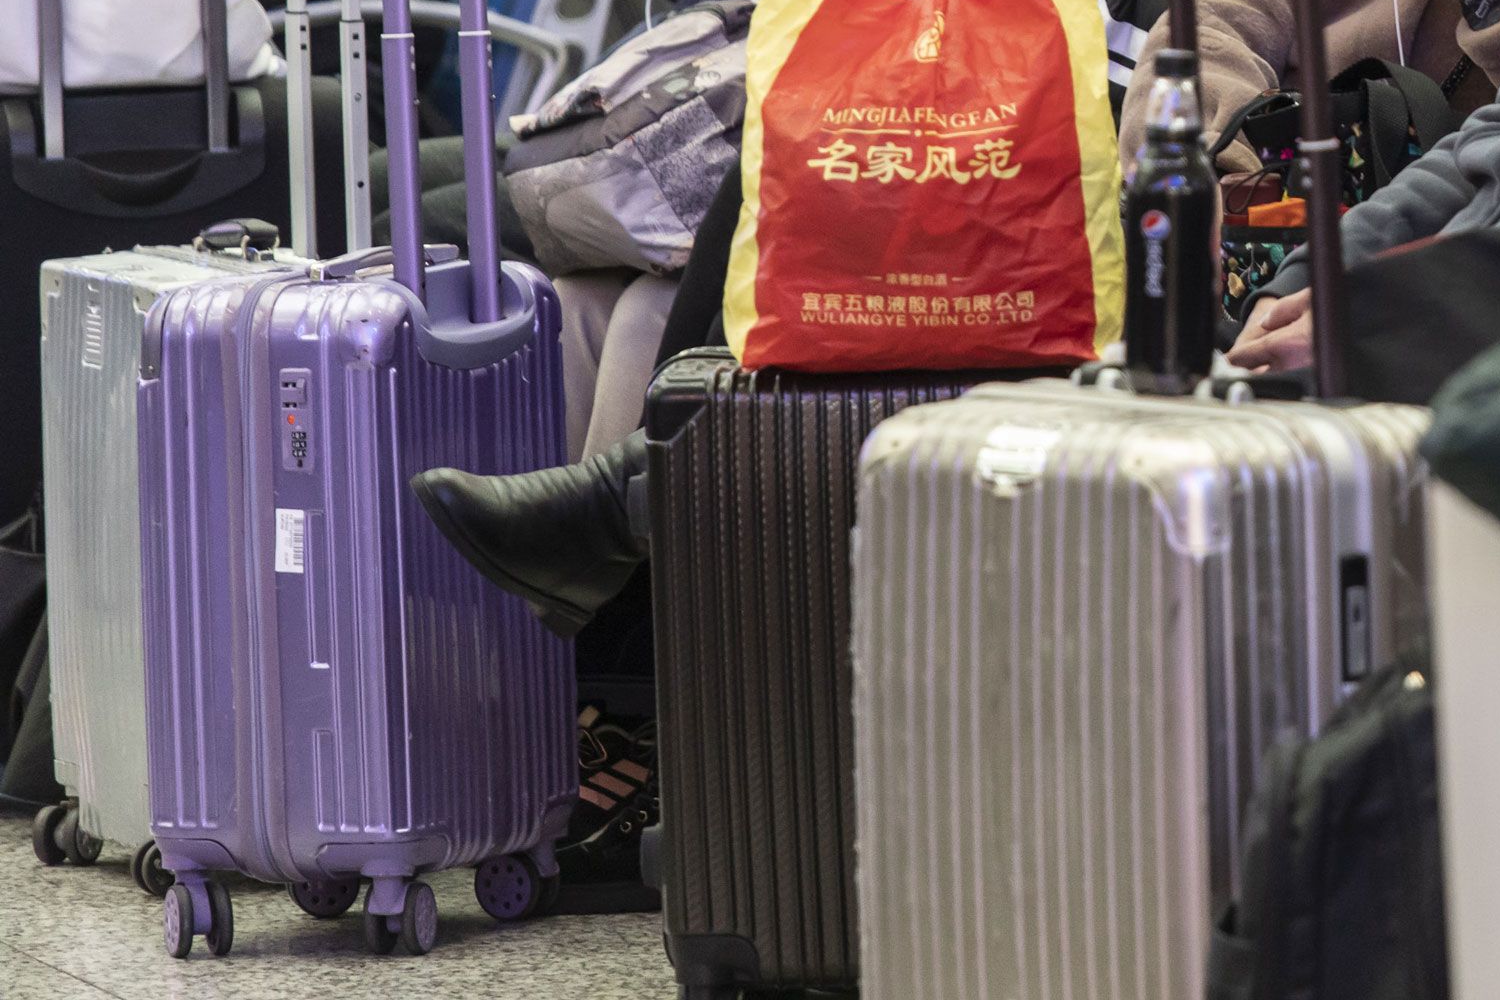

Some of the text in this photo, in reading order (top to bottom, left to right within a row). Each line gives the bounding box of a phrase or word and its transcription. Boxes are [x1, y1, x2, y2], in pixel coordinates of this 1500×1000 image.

[822, 102, 1018, 129] MINGJIAFENGFAN
[806, 137, 1022, 185] 名家风范
[801, 290, 1035, 315] 宜宾五粮液股份有限公司
[800, 311, 906, 327] WULIANGYE
[912, 314, 959, 327] YIBIN
